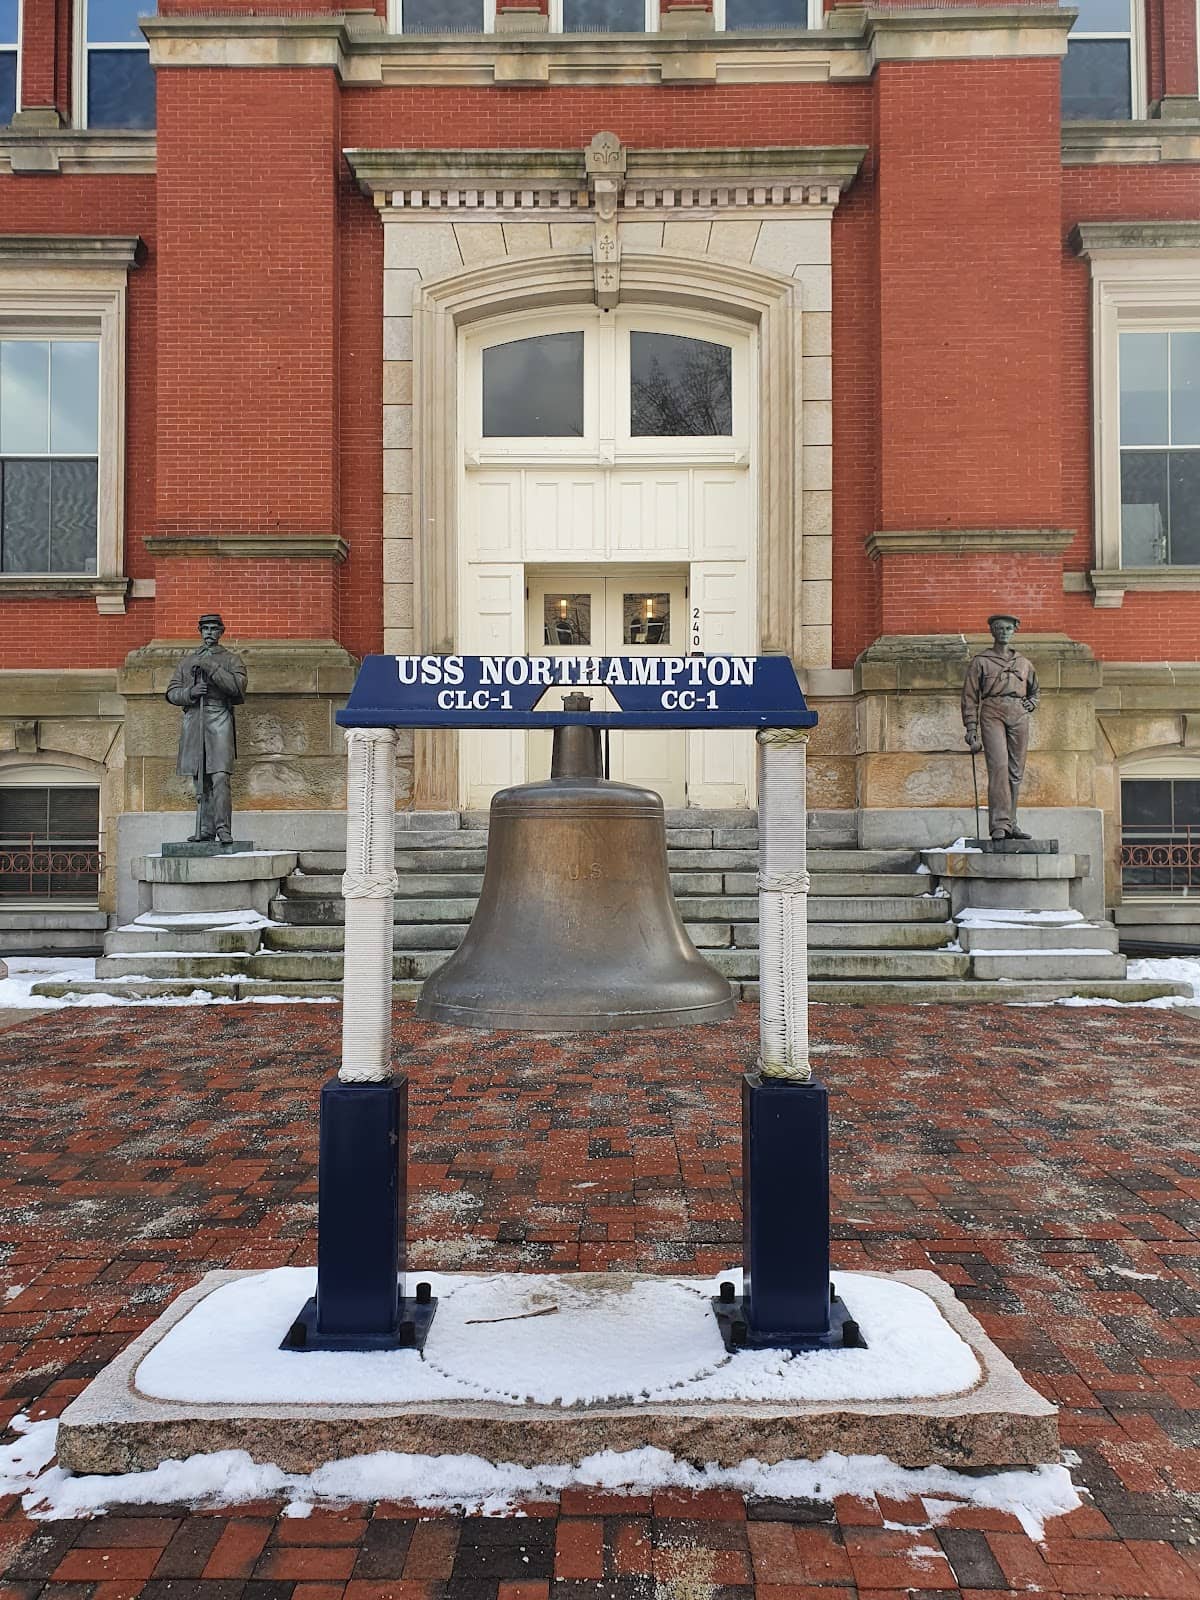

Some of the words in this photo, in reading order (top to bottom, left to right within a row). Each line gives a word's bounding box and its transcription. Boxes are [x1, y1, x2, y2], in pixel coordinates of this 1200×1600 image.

[692, 607, 700, 646] 240
[396, 655, 465, 685] USS
[479, 656, 757, 686] NORTHAMPTON
[437, 690, 513, 710] CLC-1
[661, 690, 719, 710] CC-1
